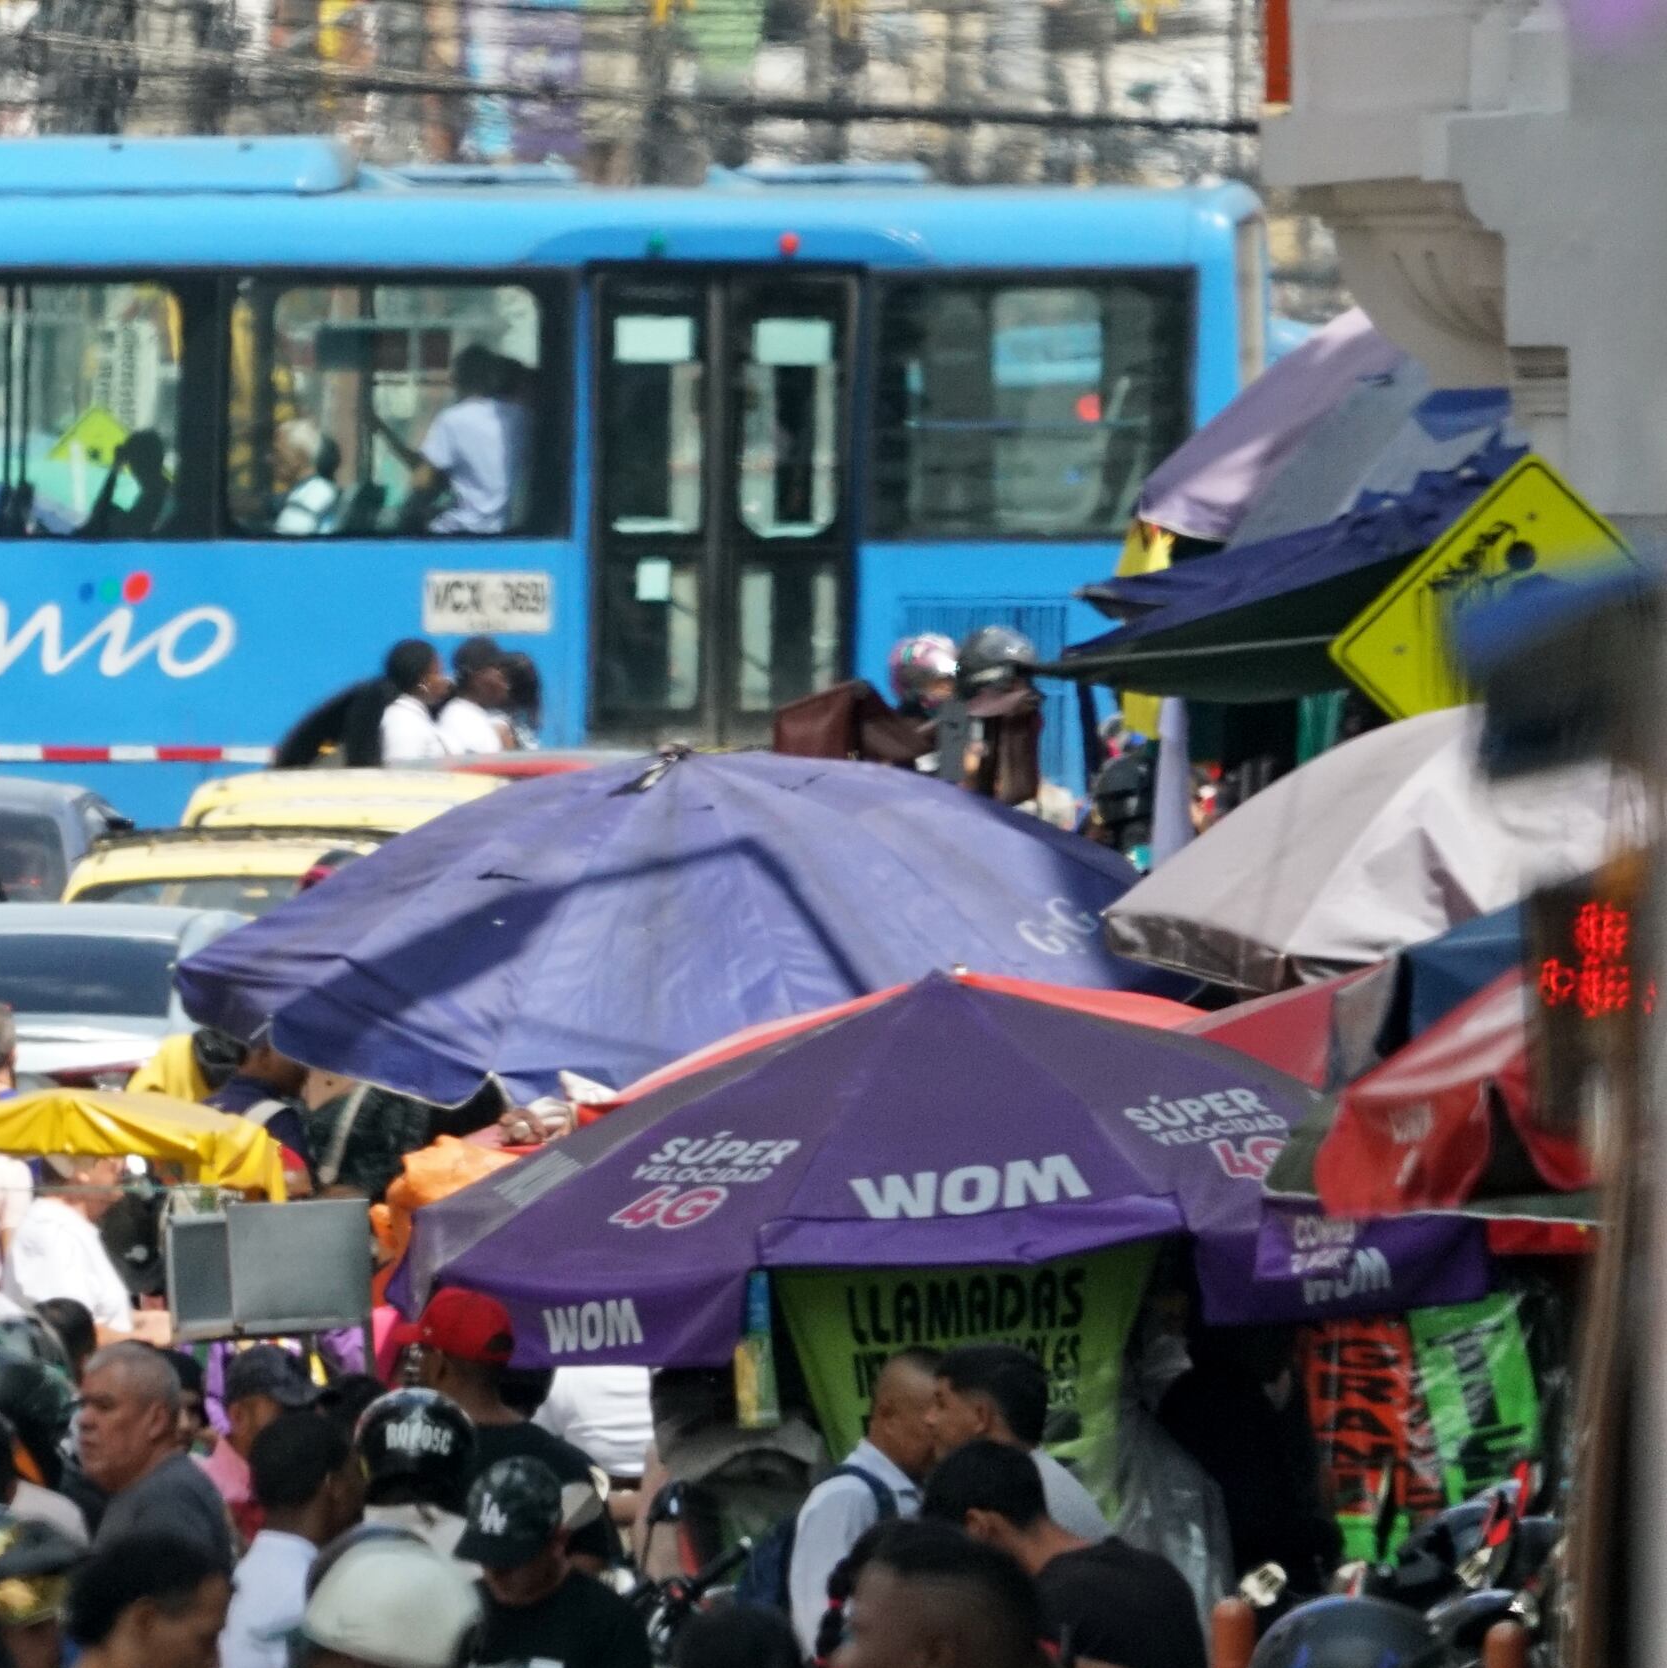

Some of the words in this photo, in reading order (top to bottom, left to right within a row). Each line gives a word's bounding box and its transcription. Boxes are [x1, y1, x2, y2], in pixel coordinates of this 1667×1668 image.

[1122, 1087, 1271, 1133] SÚPER
[1150, 1113, 1290, 1147] VELOCIDAD
[648, 1131, 802, 1168] SÚPER
[631, 1164, 774, 1184] VELOCIDAD
[848, 1153, 1093, 1221] WOM
[606, 1184, 730, 1230] 4G
[541, 1298, 644, 1355] WOM
[846, 1267, 1087, 1346] LLAMADAS
